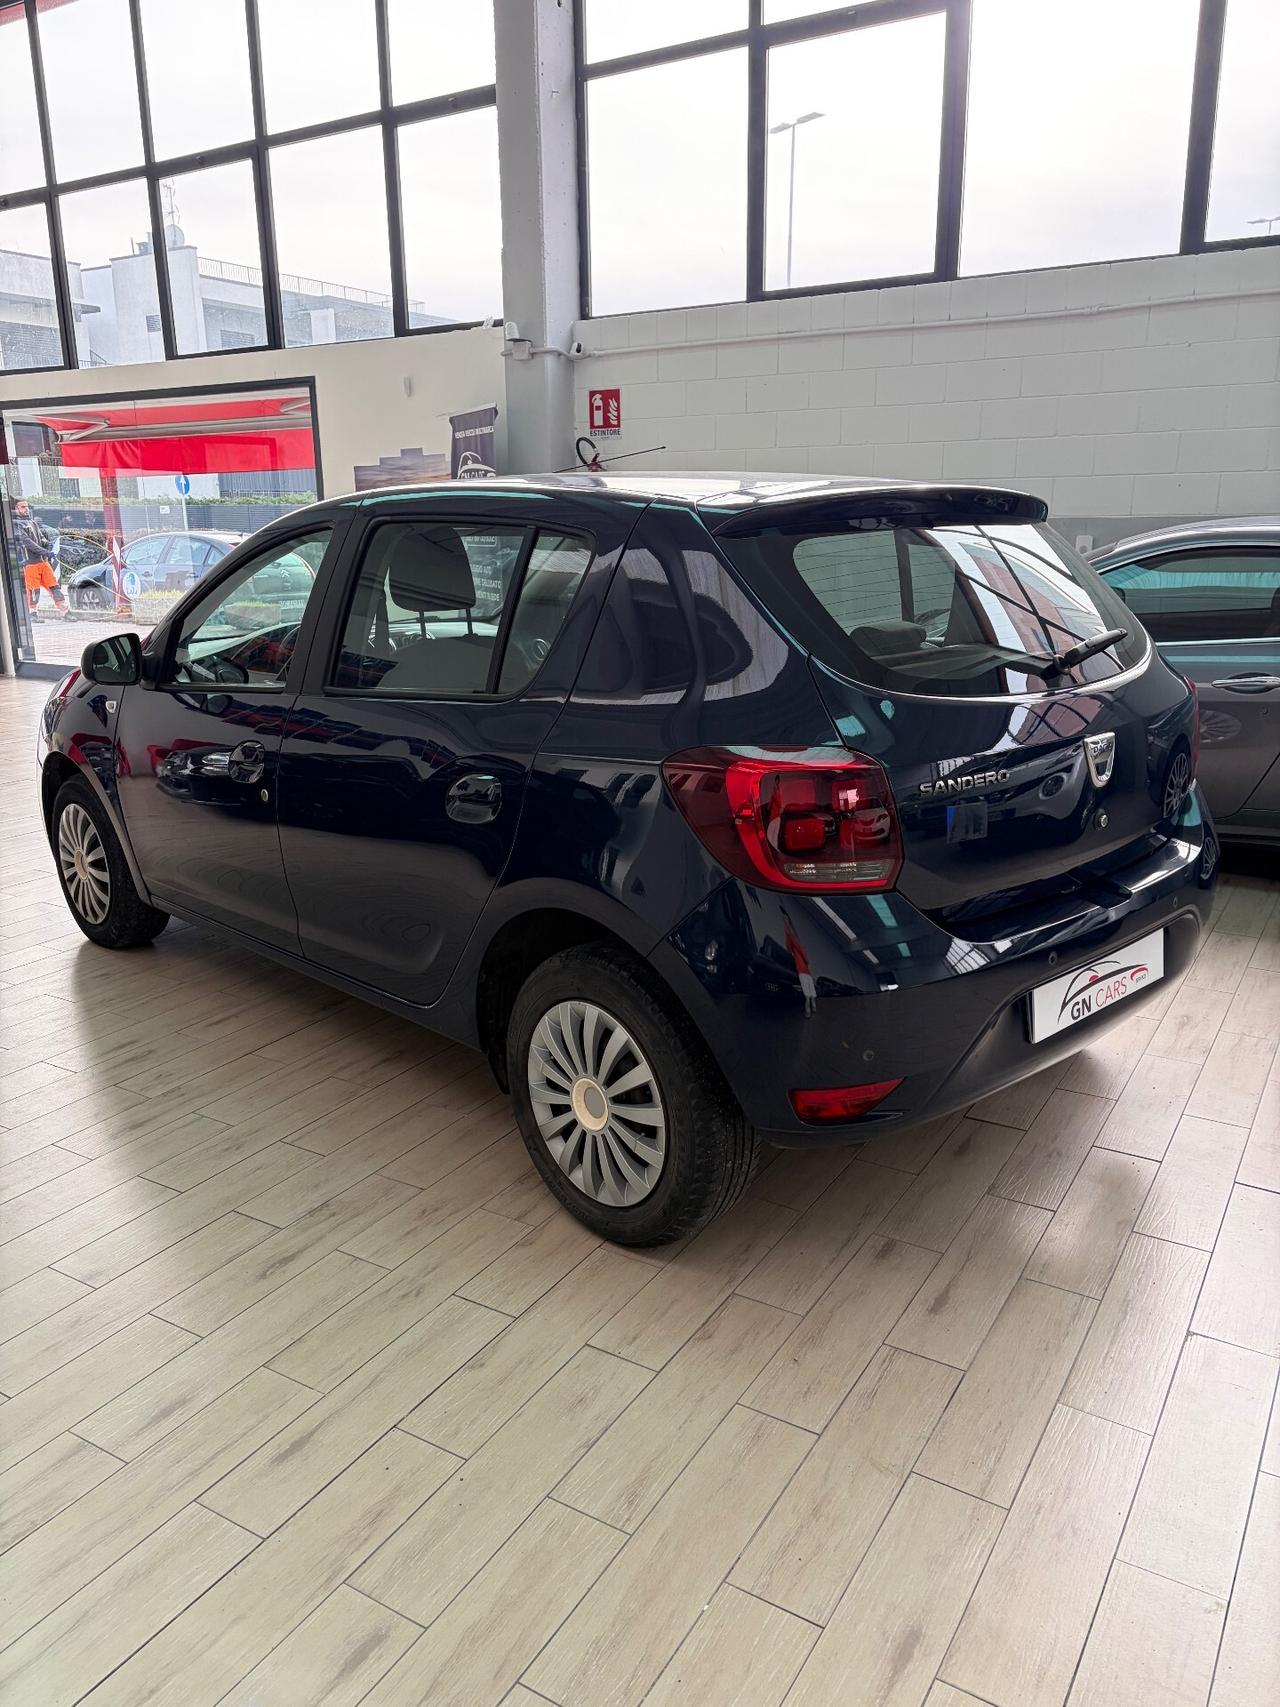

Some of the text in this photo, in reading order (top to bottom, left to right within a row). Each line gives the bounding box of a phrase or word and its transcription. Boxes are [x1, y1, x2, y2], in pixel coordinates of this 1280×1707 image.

[590, 429, 621, 437] ESTINTORE
[919, 769, 1010, 795] SANDERO
[1071, 976, 1127, 1021] GN CARS
